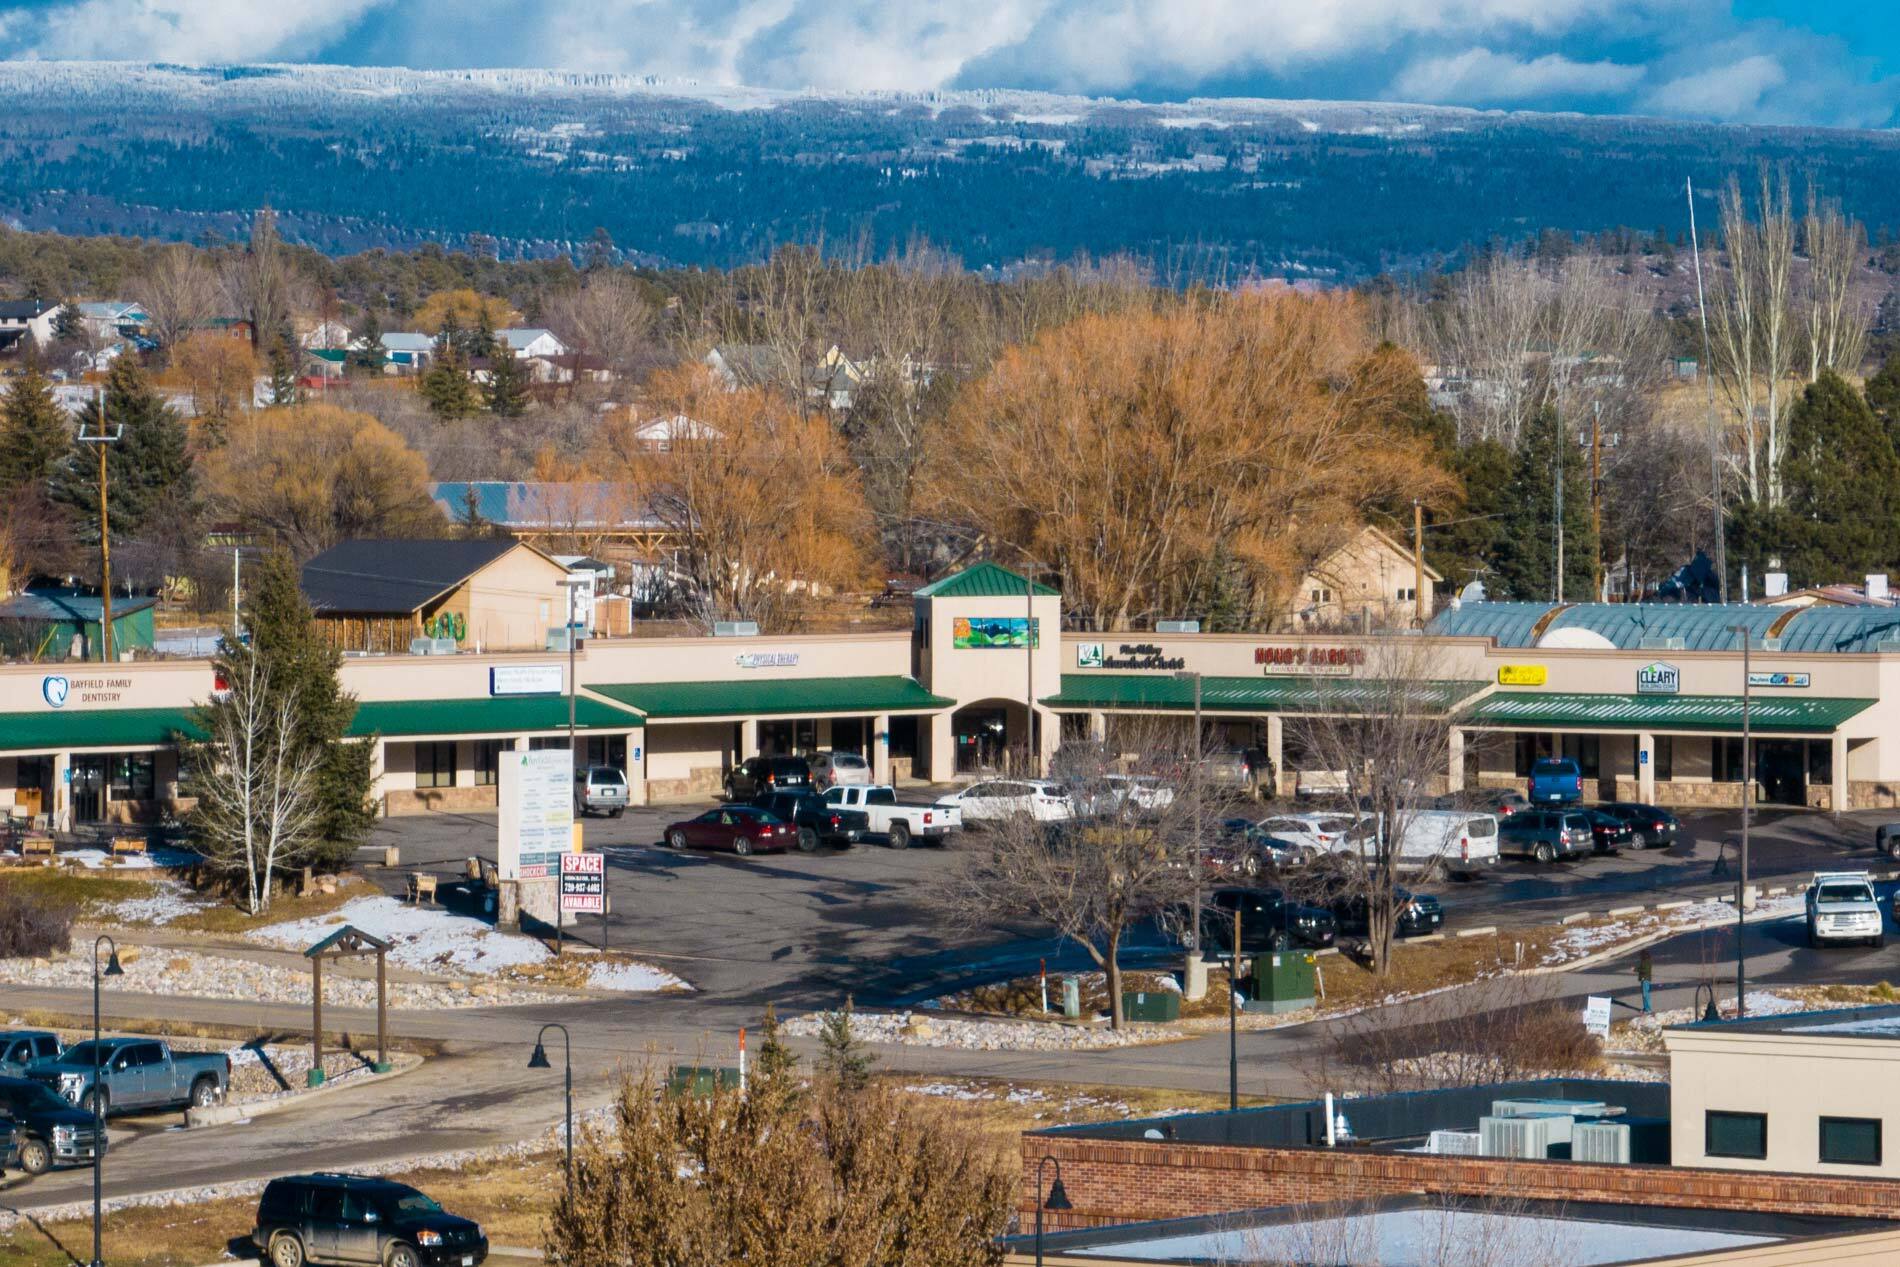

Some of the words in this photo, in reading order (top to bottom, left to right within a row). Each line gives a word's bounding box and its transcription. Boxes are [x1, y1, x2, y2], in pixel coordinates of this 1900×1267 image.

[70, 680, 104, 689] BAYFIELD
[106, 679, 132, 688] FAMILY
[1640, 671, 1676, 684] CLEARY
[82, 692, 121, 702] DENTISTRY
[565, 856, 600, 872] SPACE
[564, 896, 600, 909] AVAILABLE
